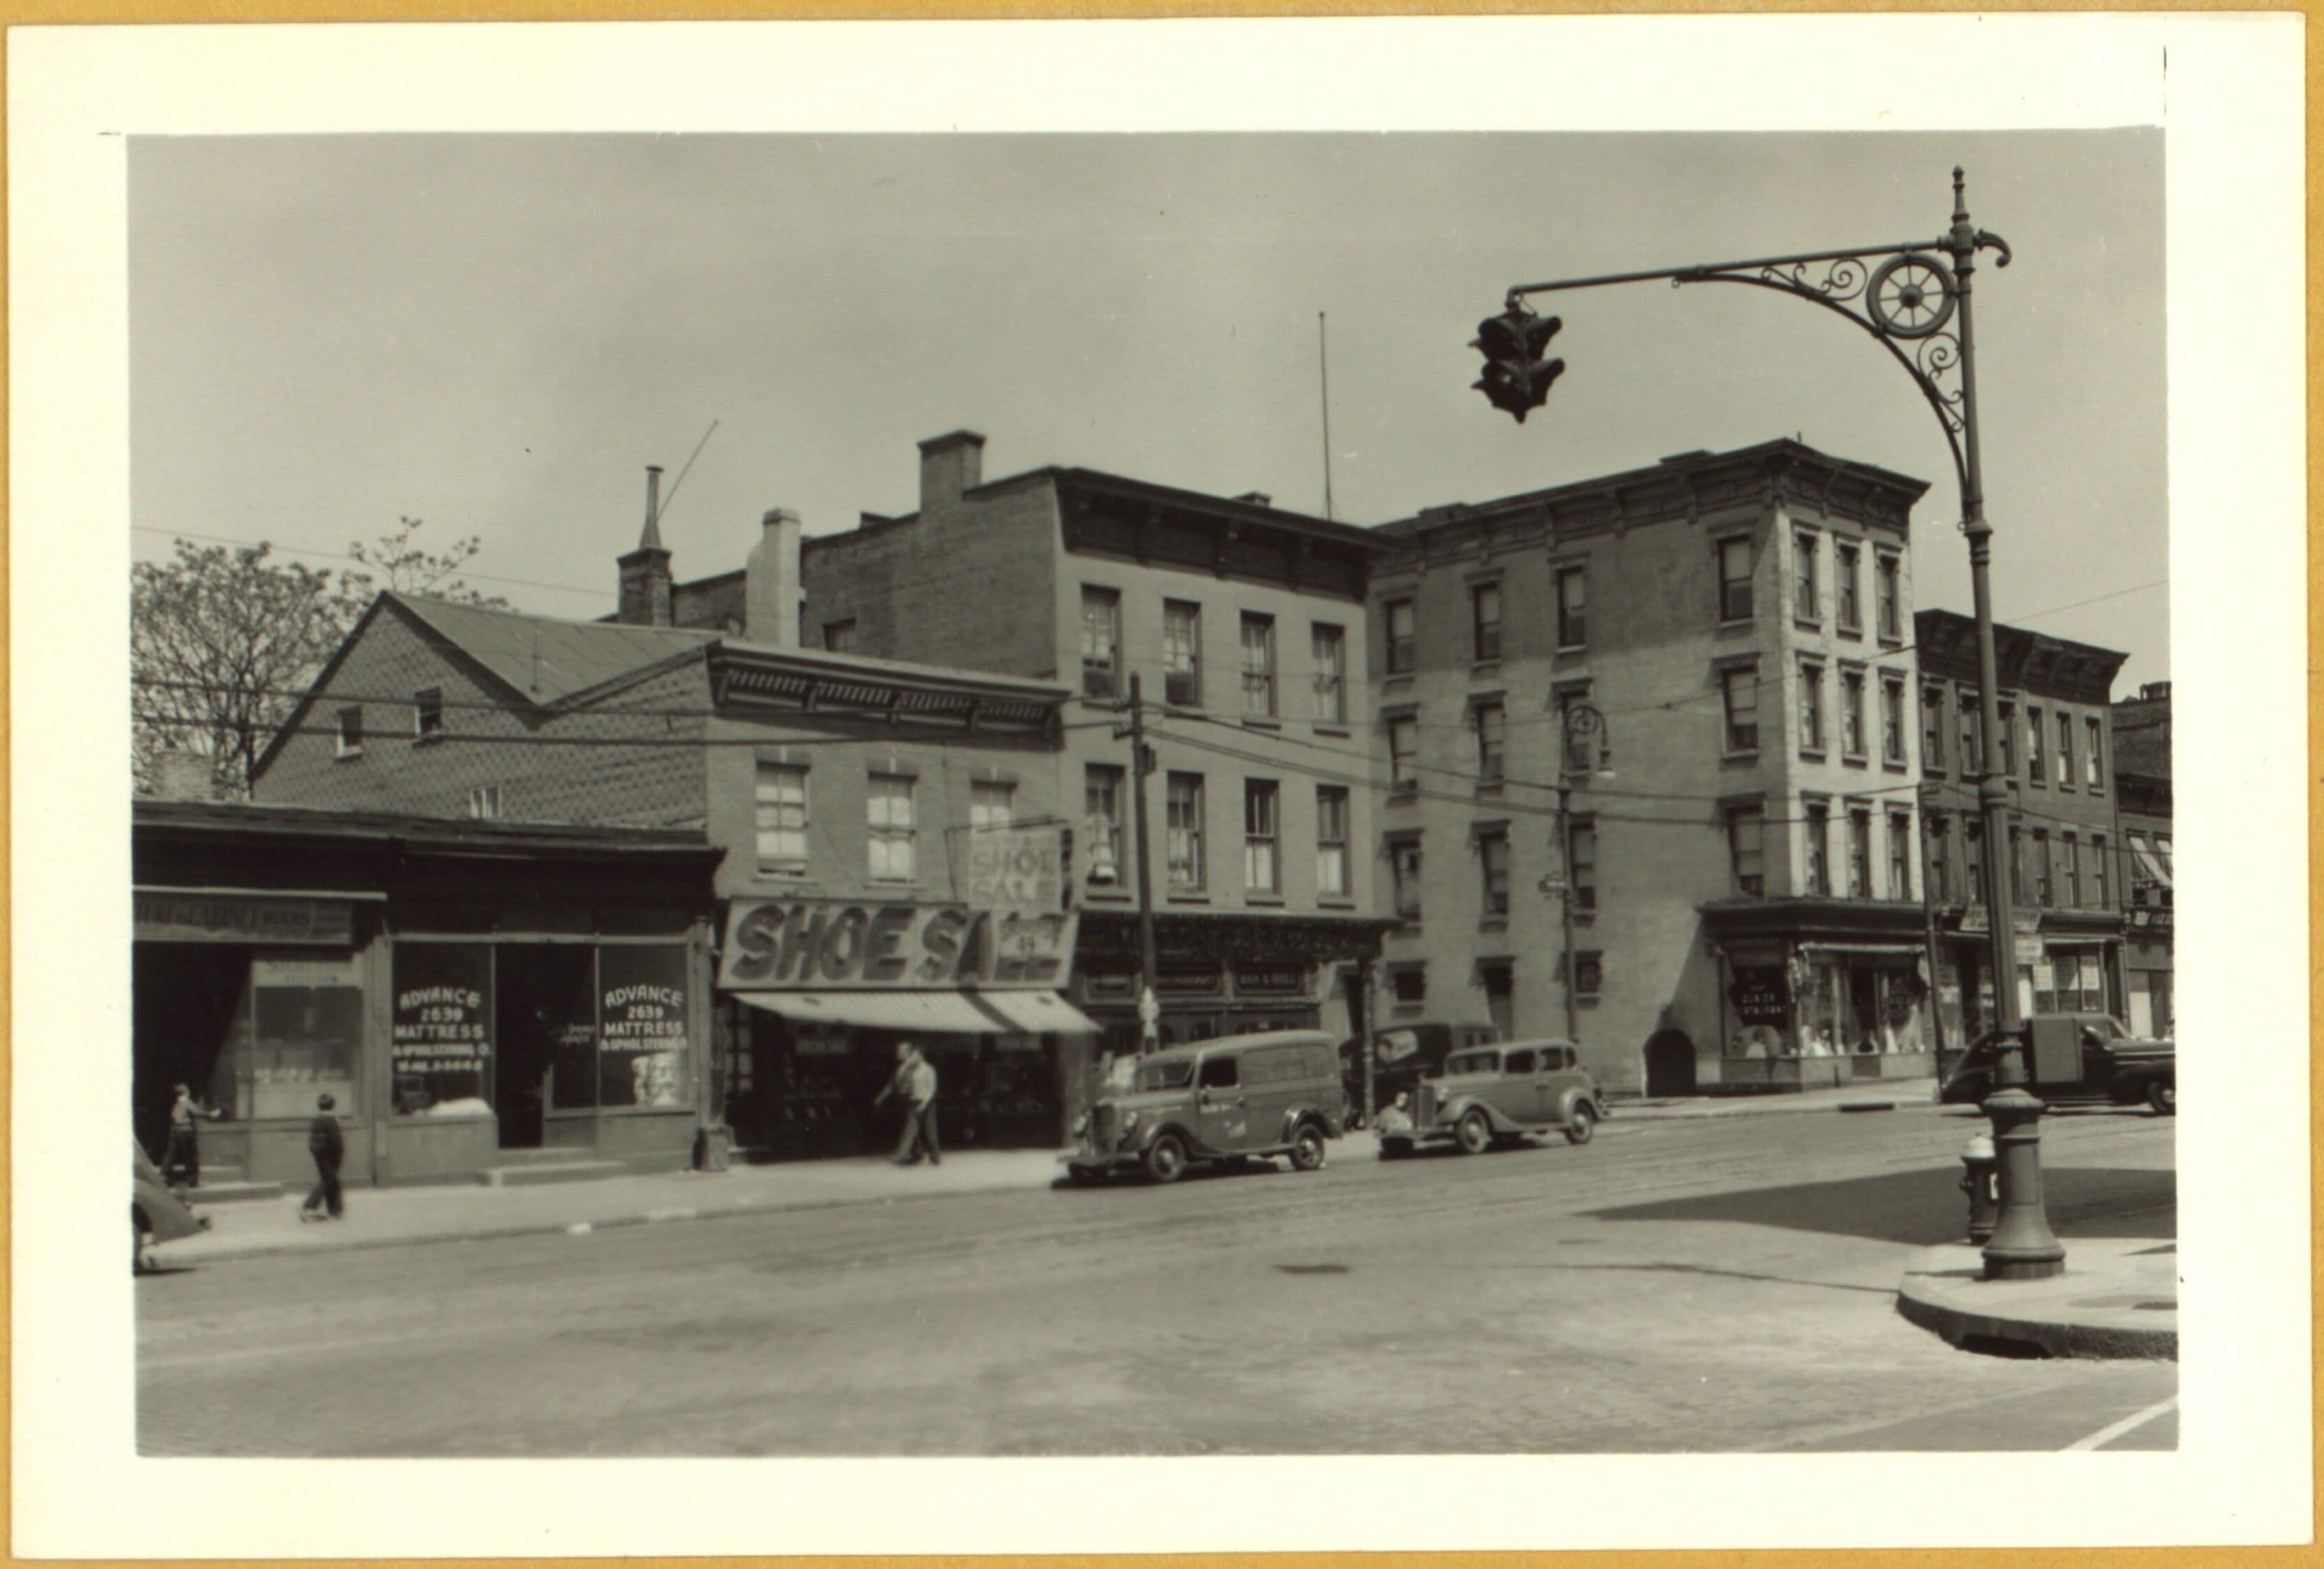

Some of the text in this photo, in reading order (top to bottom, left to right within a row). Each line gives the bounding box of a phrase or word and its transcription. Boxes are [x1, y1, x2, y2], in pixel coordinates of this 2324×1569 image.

[729, 903, 916, 981] SHOE
[399, 986, 482, 1010] ADVANCE
[605, 985, 684, 1008] ADVANCE
[627, 1005, 664, 1020] 2639
[394, 1024, 484, 1039] MATTRESS
[605, 1021, 684, 1035] MATTRESS
